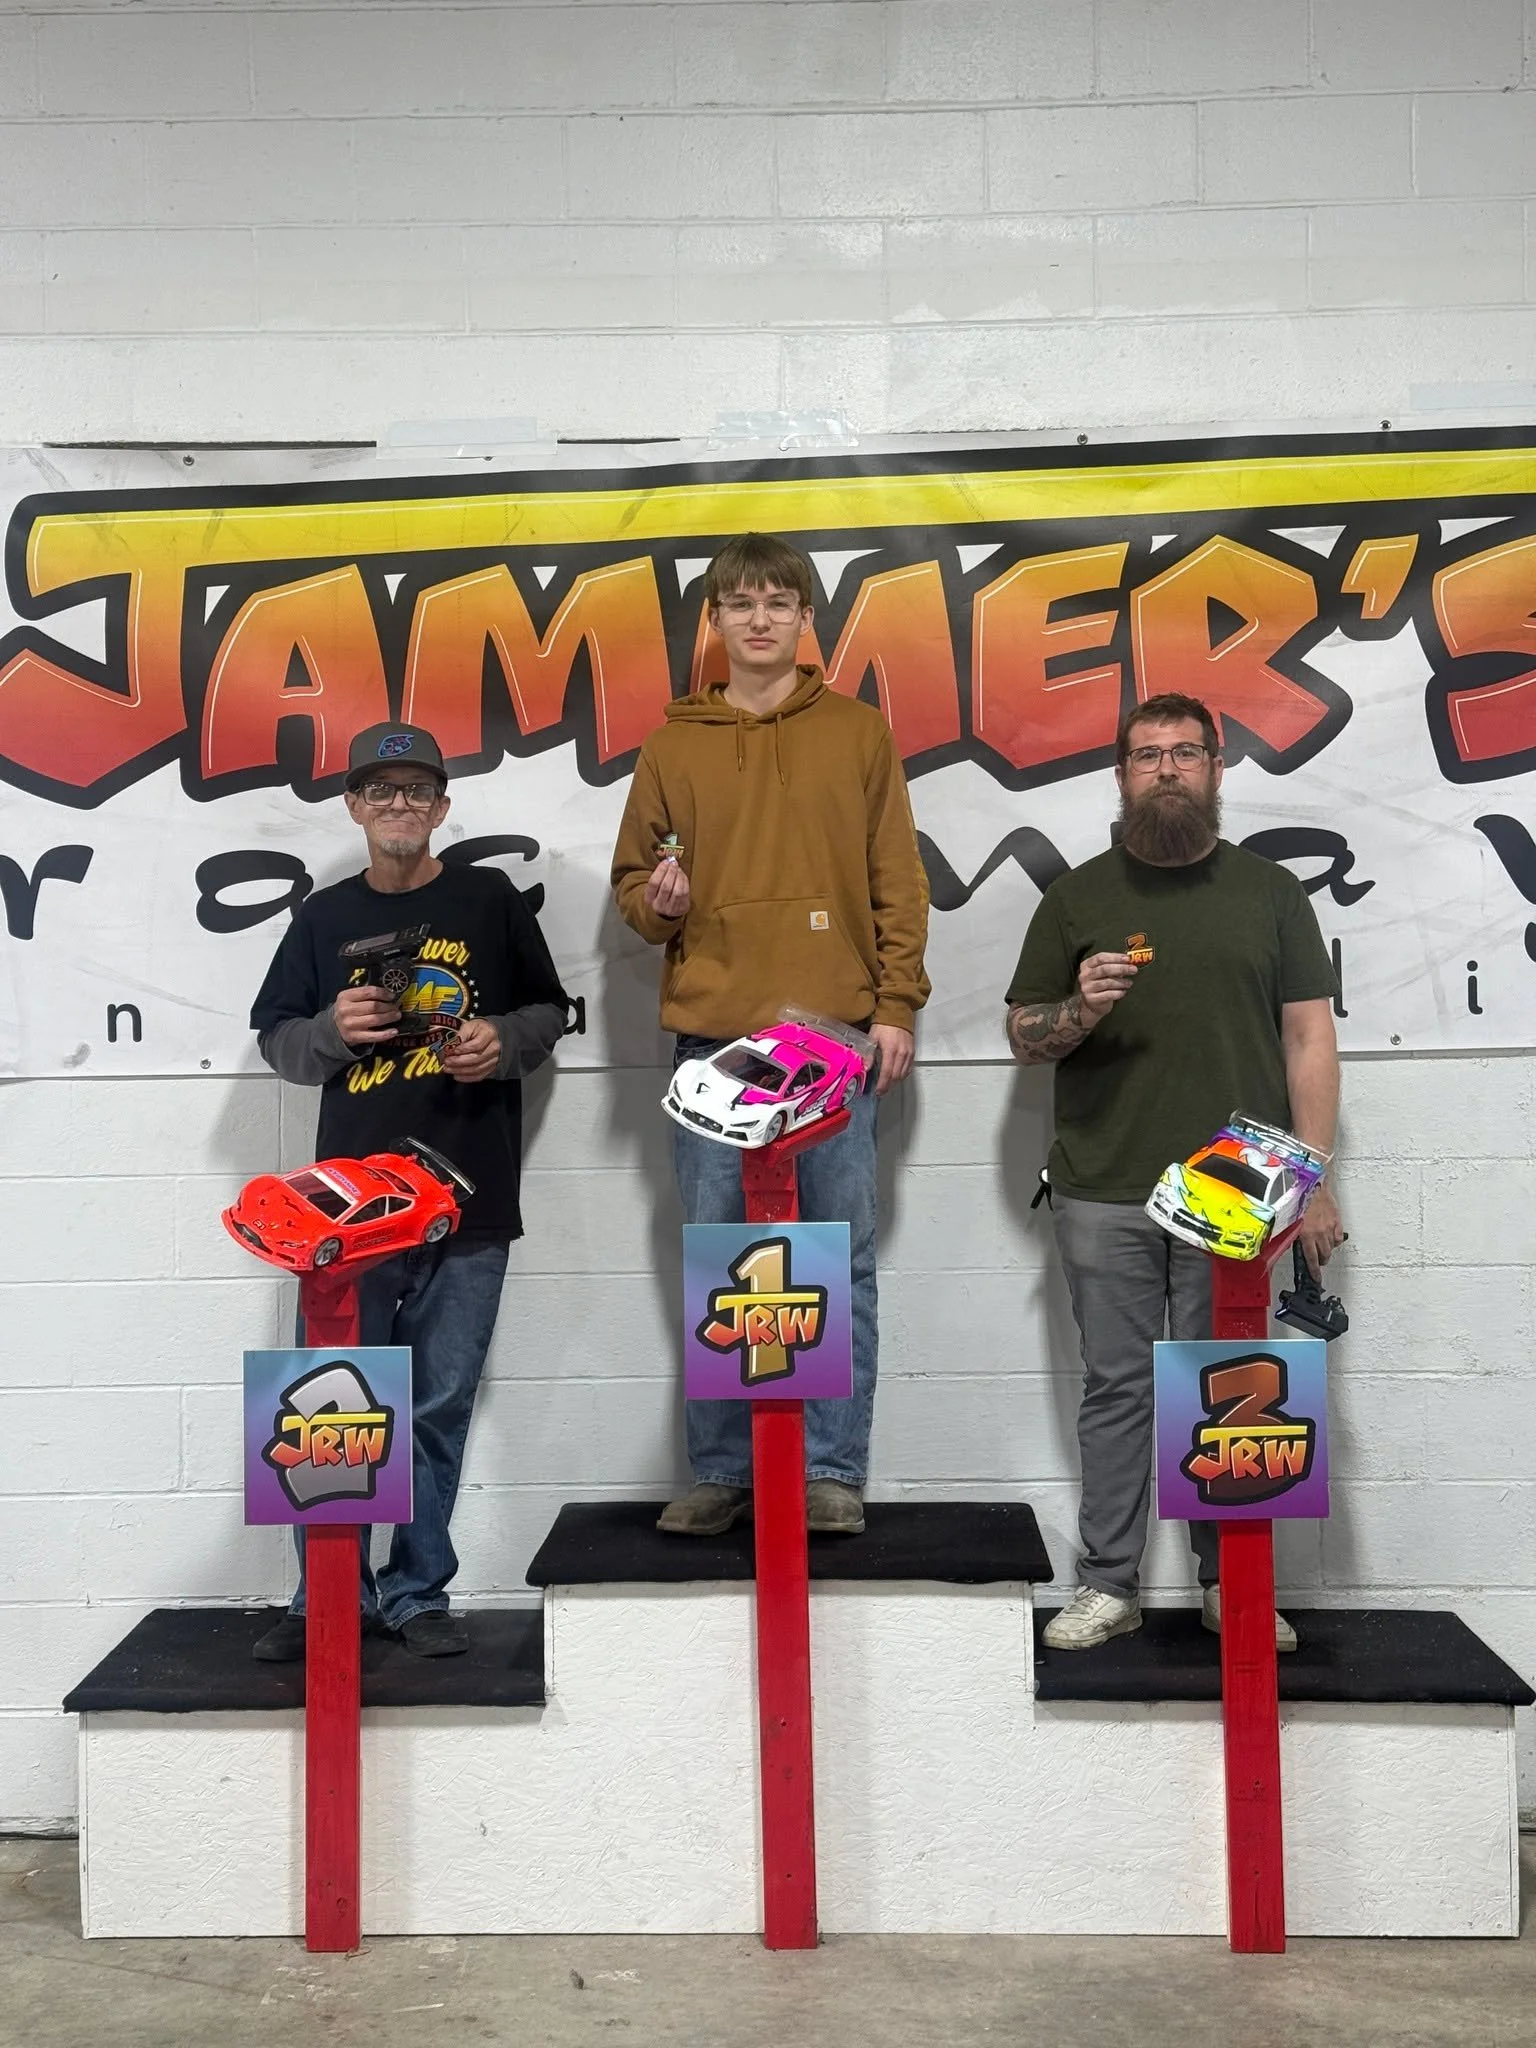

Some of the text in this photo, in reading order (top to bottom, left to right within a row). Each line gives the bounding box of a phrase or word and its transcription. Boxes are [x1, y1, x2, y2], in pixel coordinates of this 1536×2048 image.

[347, 1047, 443, 1093] We Tru
[703, 1292, 820, 1347] JRW
[269, 1412, 387, 1468] JRW
[1188, 1425, 1308, 1480] JRW
